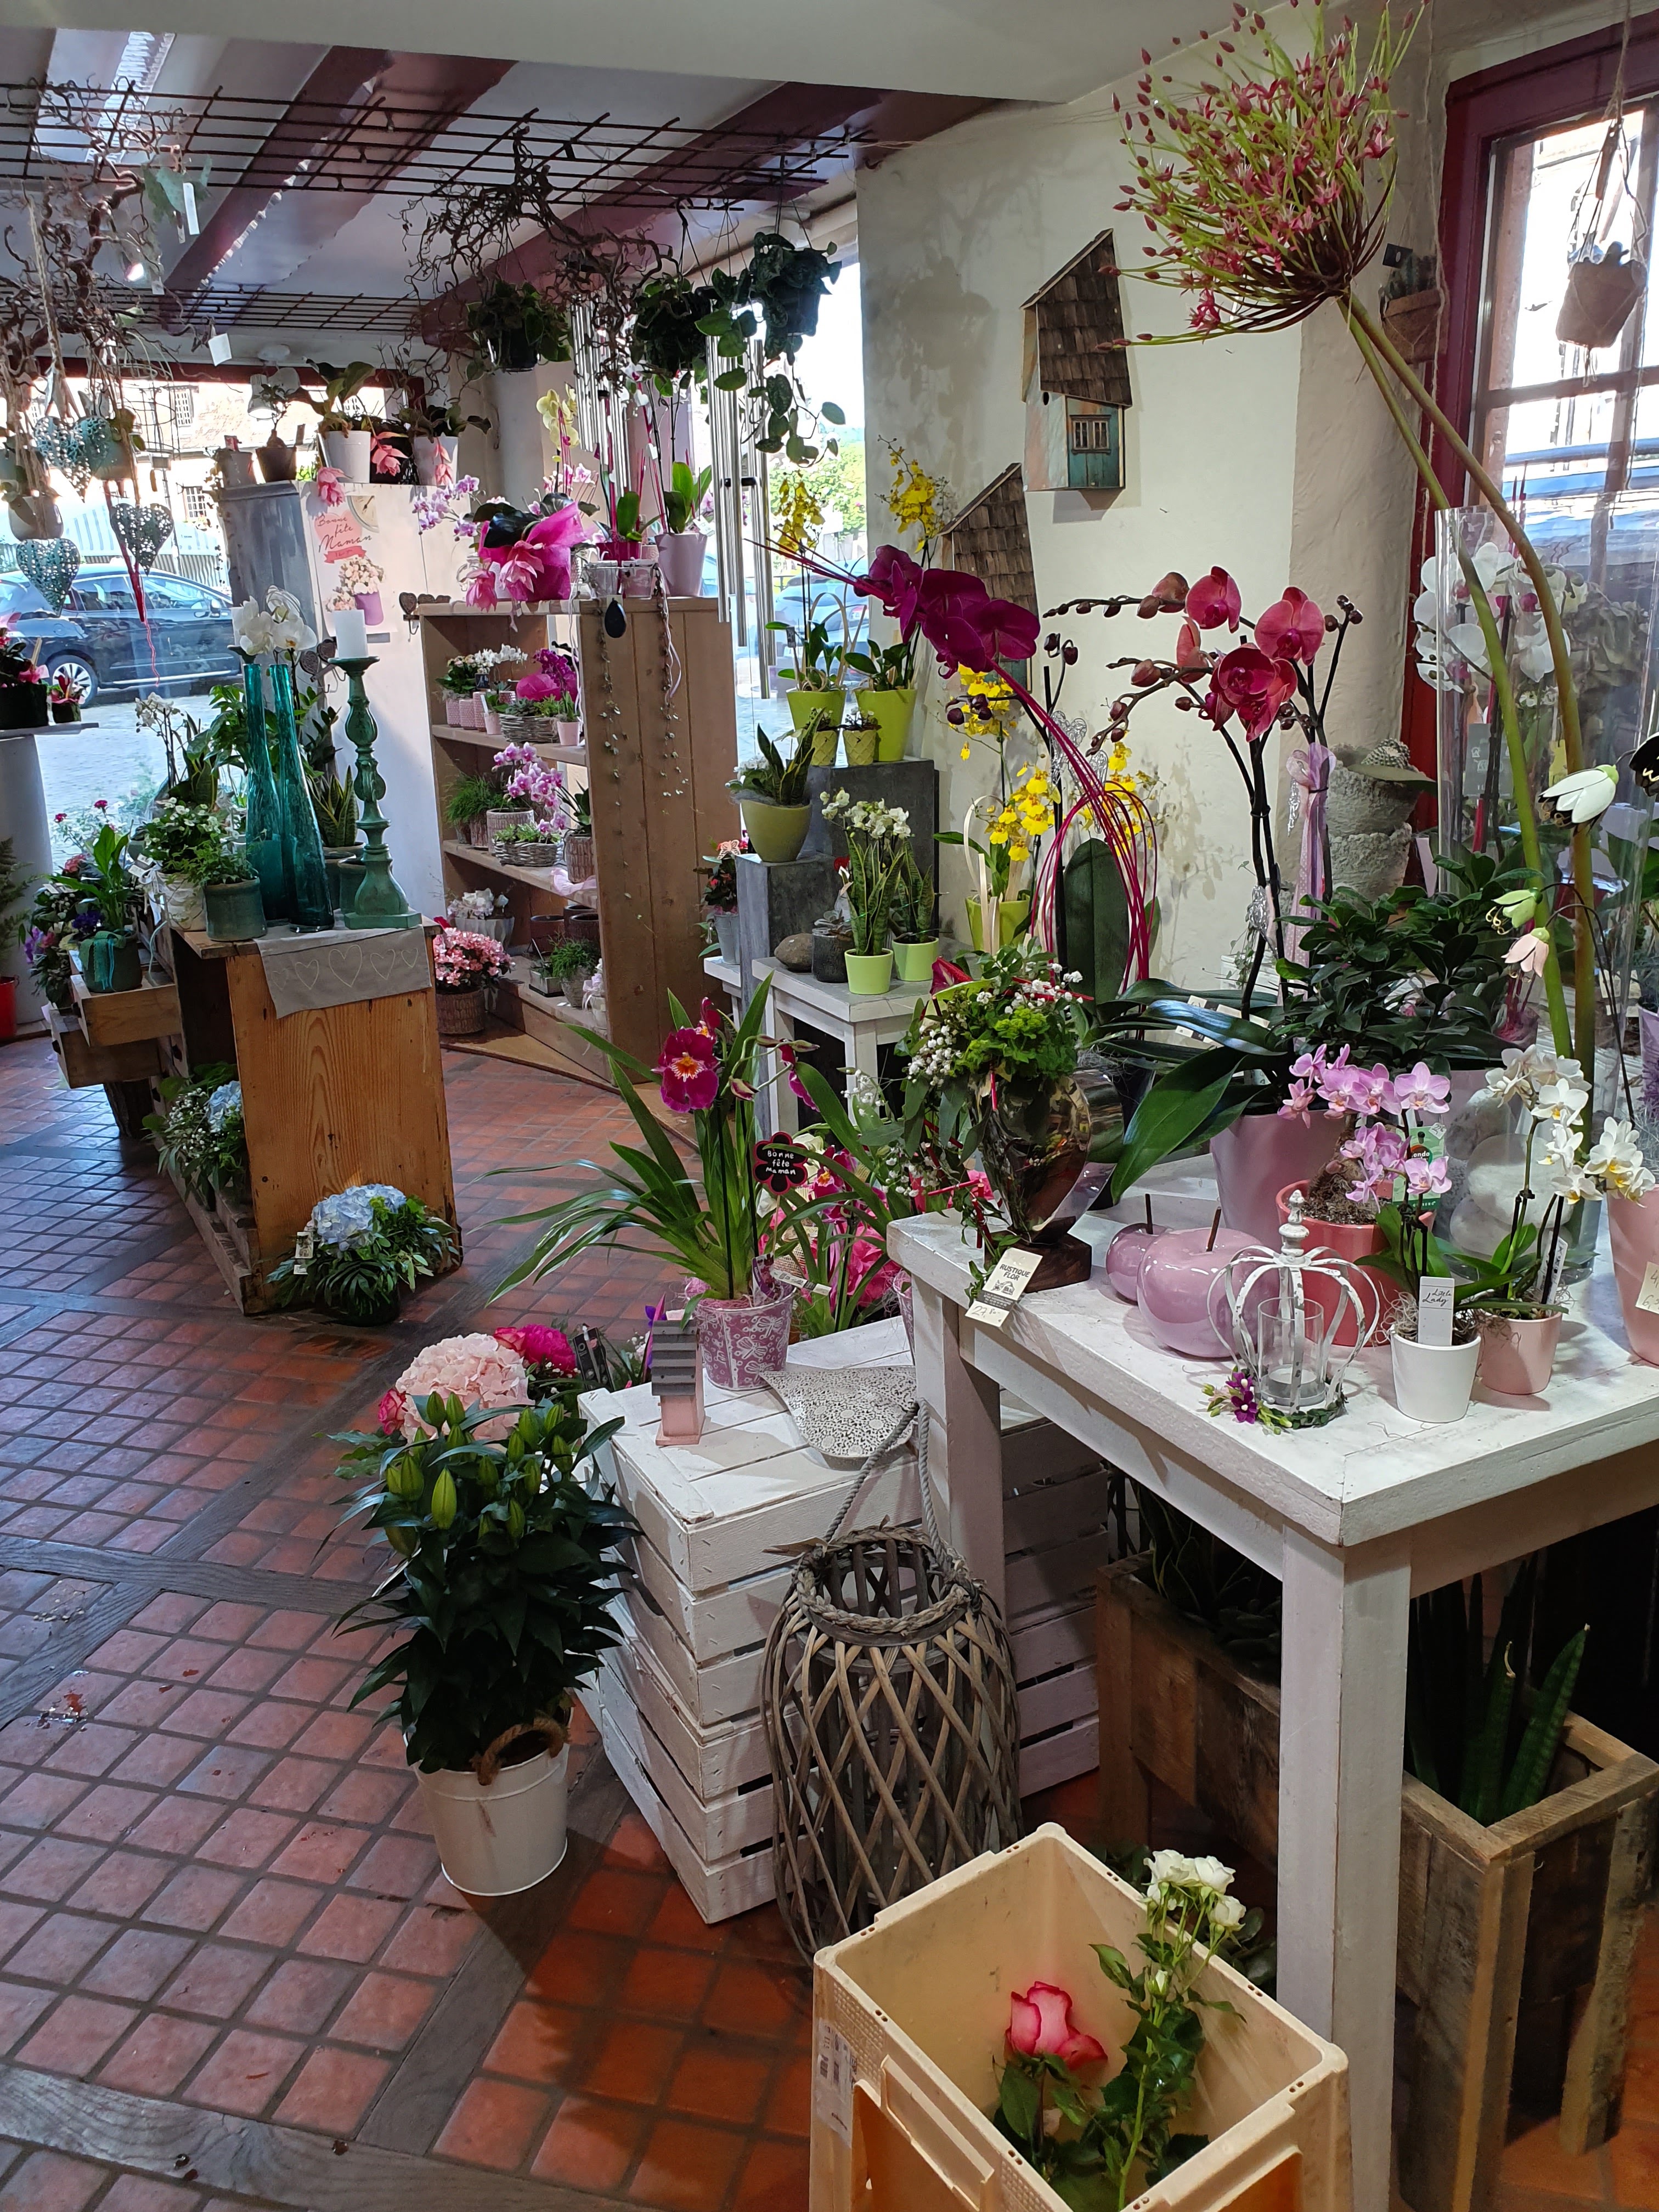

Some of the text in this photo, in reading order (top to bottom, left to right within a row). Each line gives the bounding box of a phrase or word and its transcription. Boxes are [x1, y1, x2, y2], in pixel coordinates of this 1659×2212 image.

[315, 514, 347, 527] Bonne
[335, 523, 353, 538] fête
[318, 534, 372, 553] Maman
[767, 1150, 794, 1159] Bonne
[772, 1159, 790, 1167] fête
[765, 1166, 796, 1175] Maman
[1000, 1264, 1031, 1278] RUSTIQUE
[1003, 1272, 1020, 1281] FLOR
[1422, 1293, 1449, 1307] Lady
